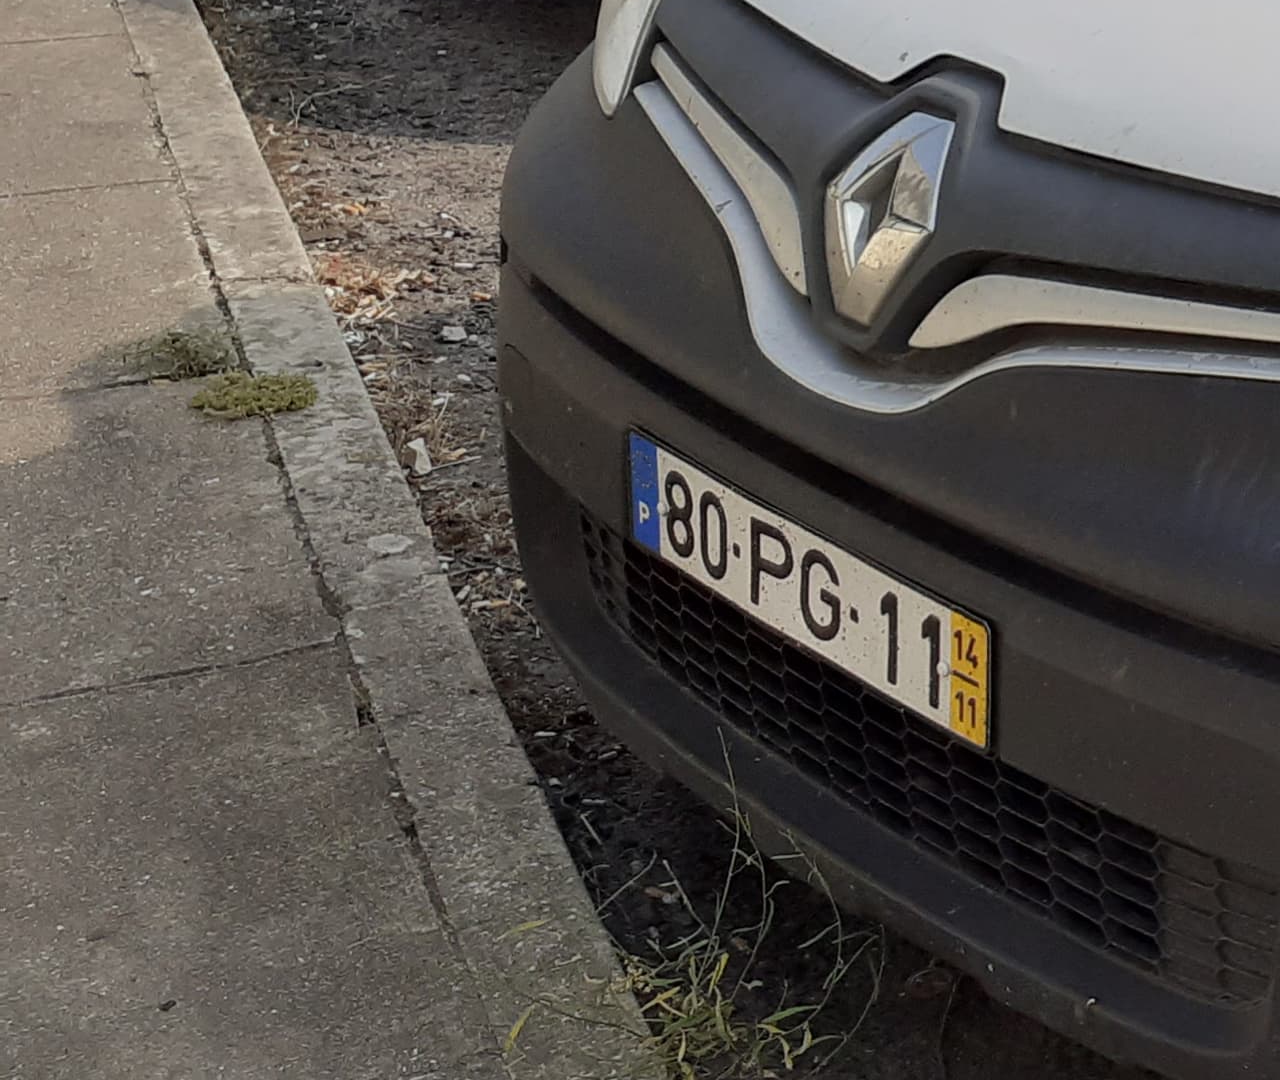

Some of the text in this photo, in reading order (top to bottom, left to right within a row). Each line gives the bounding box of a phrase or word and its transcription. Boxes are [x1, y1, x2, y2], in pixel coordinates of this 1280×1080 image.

[638, 500, 651, 524] P
[953, 630, 980, 671] 14
[954, 691, 978, 729] 11
